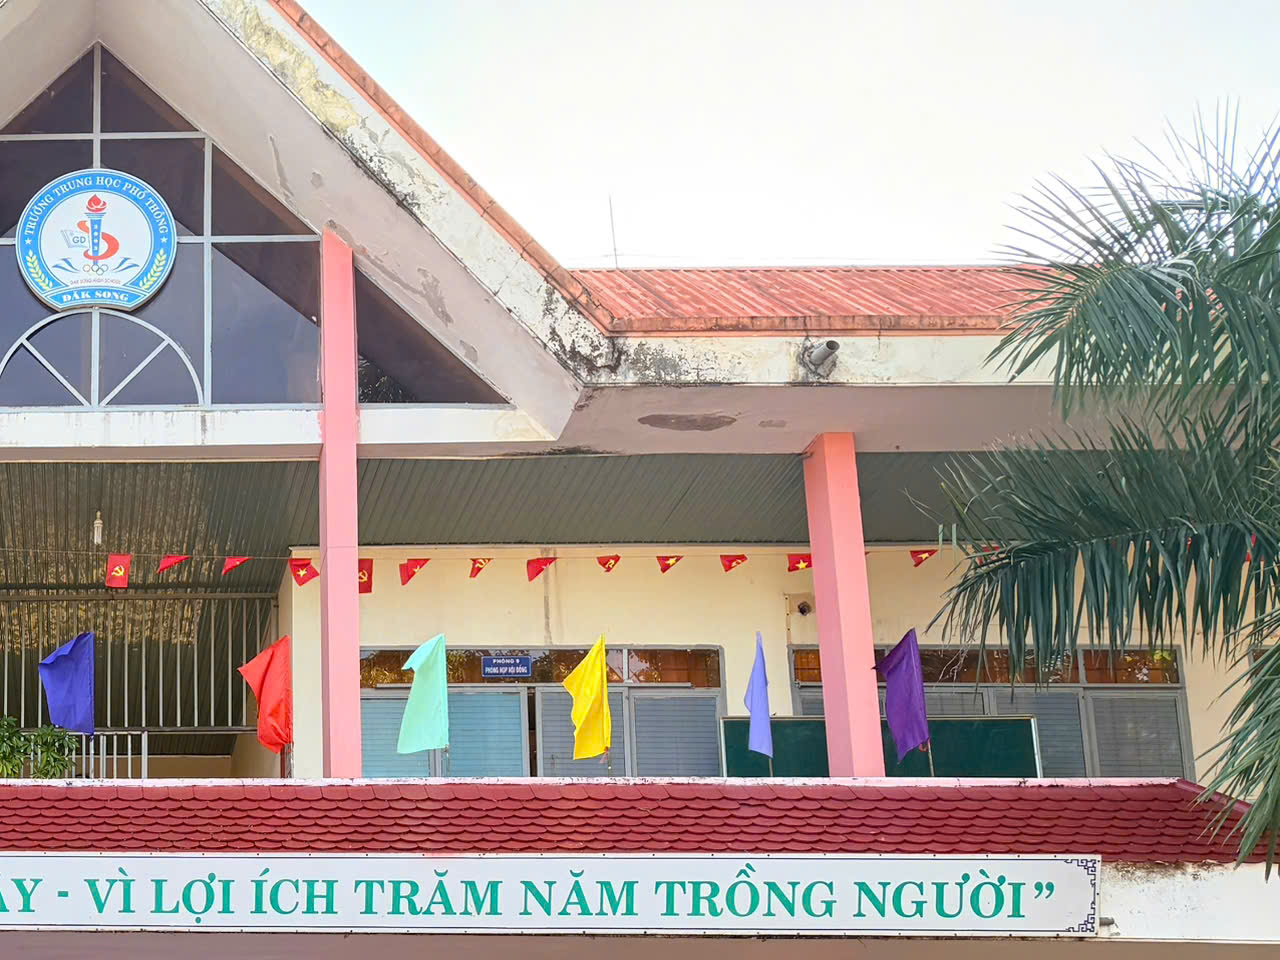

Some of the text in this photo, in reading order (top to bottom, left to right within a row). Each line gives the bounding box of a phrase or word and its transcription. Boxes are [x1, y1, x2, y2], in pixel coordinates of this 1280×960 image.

[53, 176, 93, 197] TRUNG
[95, 176, 121, 188] HỌC
[145, 197, 169, 234] THÔNG
[95, 290, 129, 302] SONG
[86, 866, 135, 915] VÌ
[152, 870, 234, 924] LỢI
[251, 867, 338, 915] ÍCH
[354, 869, 503, 917] TRĂM
[519, 869, 637, 917] NĂM
[655, 863, 836, 919] TRỒNG
